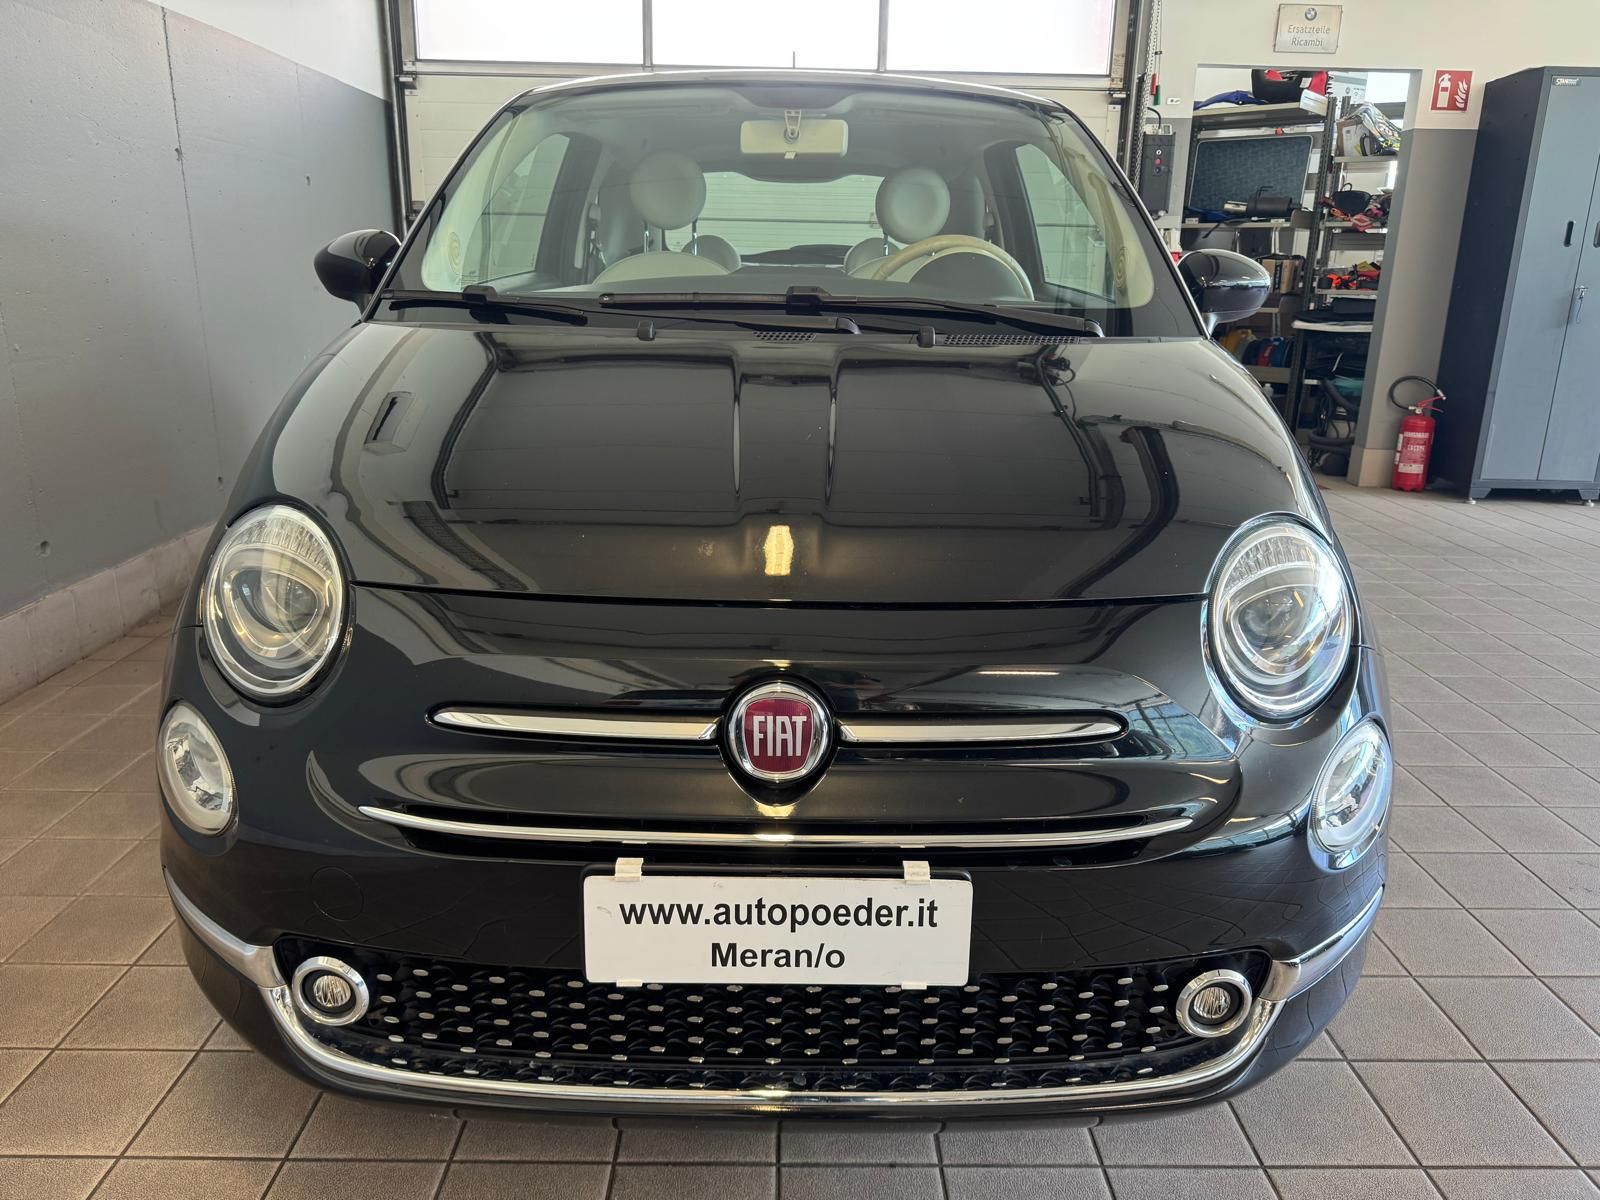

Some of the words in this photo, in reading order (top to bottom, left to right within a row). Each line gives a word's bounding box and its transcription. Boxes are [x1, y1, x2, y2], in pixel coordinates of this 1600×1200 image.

[1288, 24, 1331, 34] Ersatzteile
[1291, 37, 1323, 47] Ricambi
[753, 715, 807, 757] FIAT
[619, 898, 938, 933] www.autopoeder.it
[711, 942, 846, 969] Meran/o
